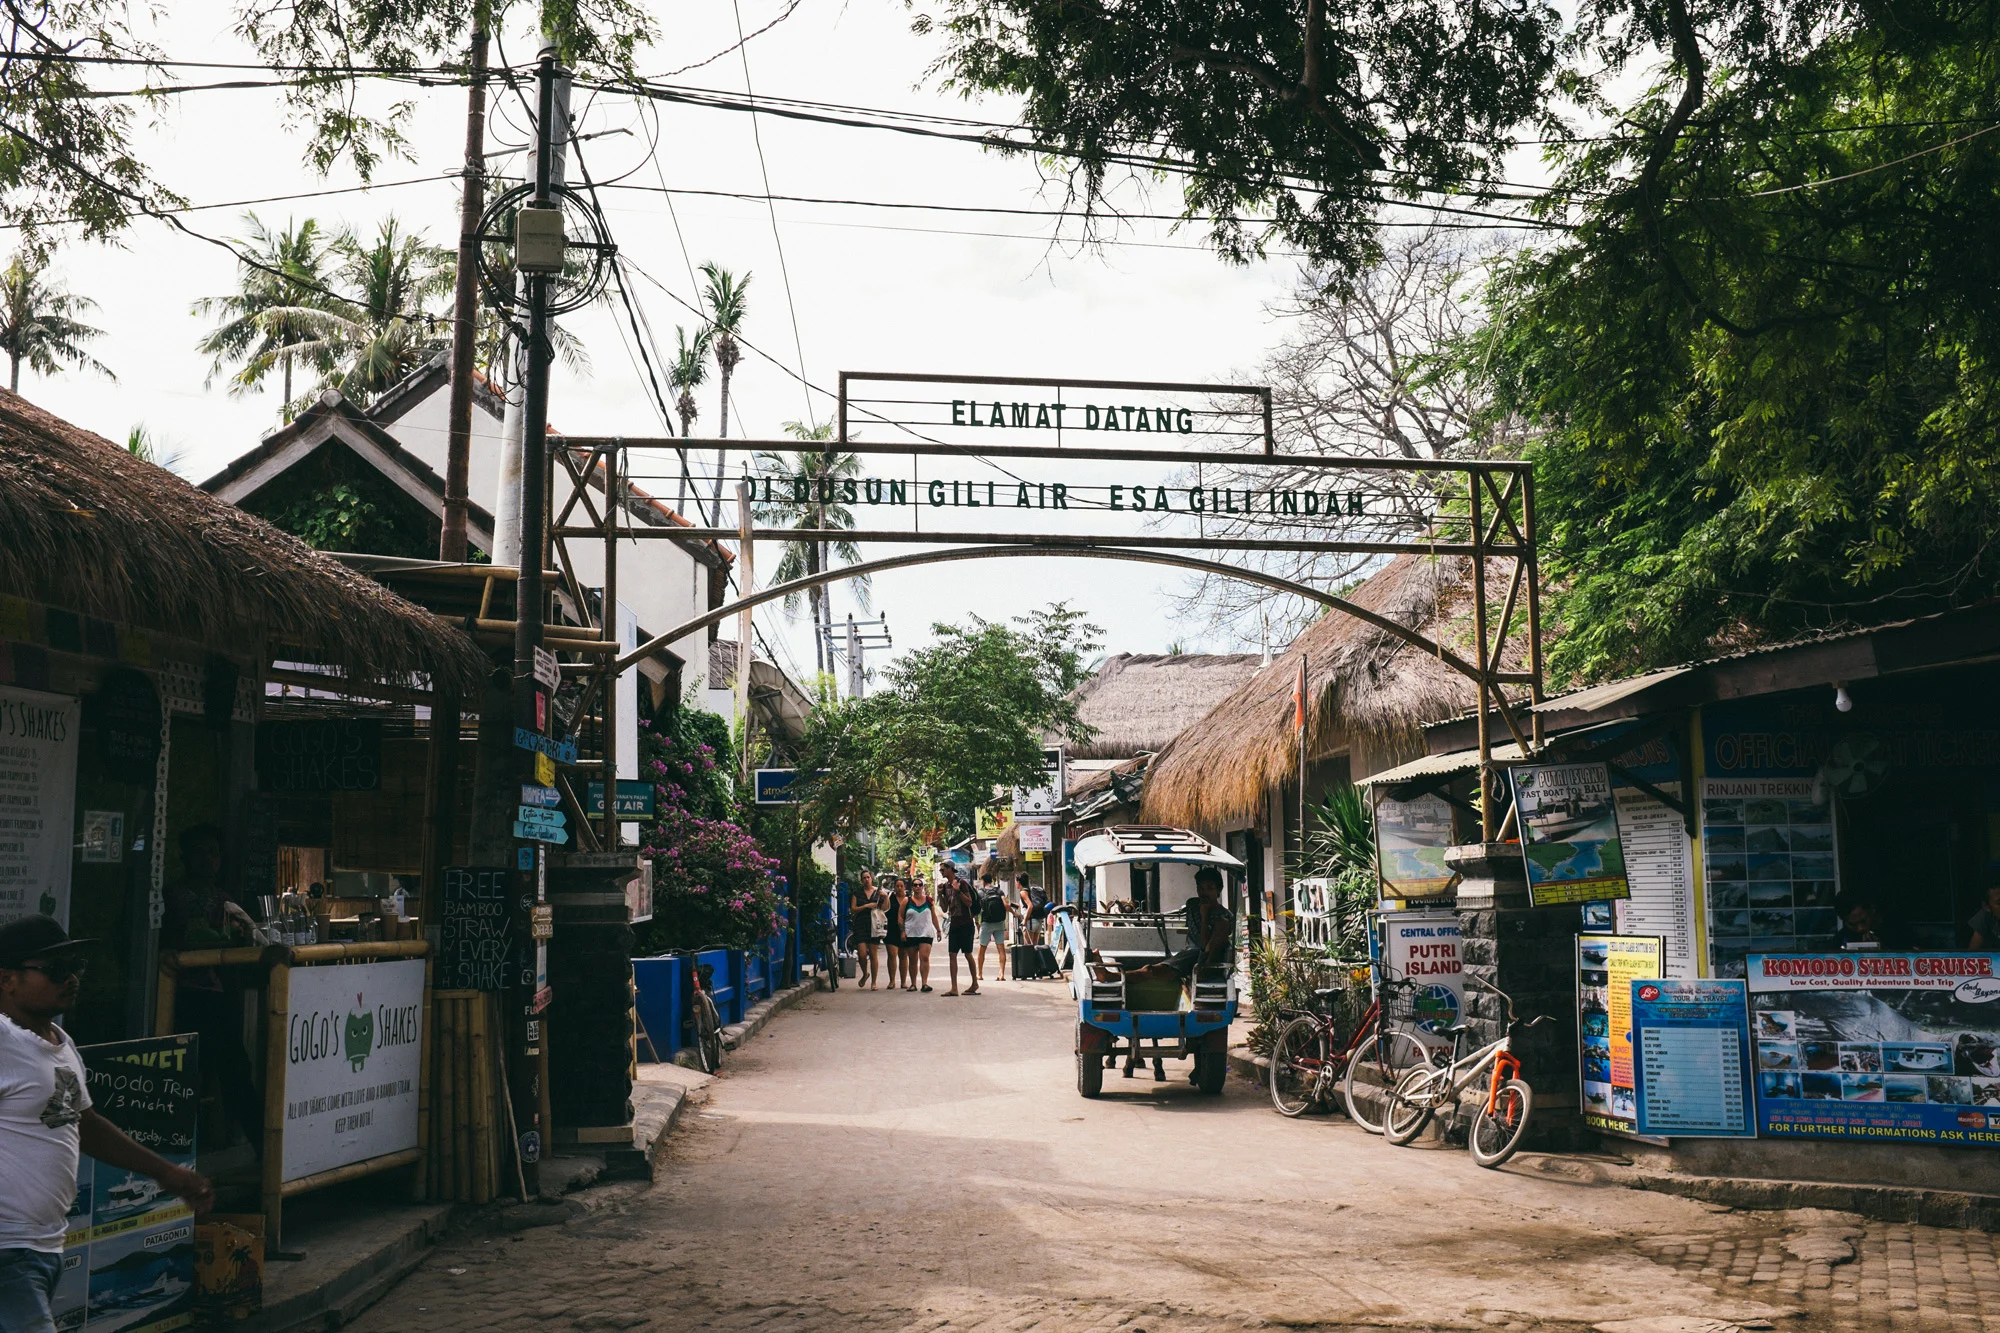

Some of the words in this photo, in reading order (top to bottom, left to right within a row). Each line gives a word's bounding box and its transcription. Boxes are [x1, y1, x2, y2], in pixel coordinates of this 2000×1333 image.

[952, 400, 1066, 429] ELAMAT
[1086, 404, 1193, 434] DATANG
[794, 476, 907, 506] DUSUN
[928, 479, 994, 508] GILI
[1016, 482, 1068, 510] AIR
[1110, 485, 1170, 513] ESA
[1189, 486, 1251, 514] GILI
[1270, 488, 1364, 517] INDAH
[20, 701, 67, 742] SHAKES
[1715, 730, 1832, 770] OFFICIA
[272, 755, 378, 790] SHAKES
[1538, 769, 1568, 788] PUTRI
[1569, 766, 1606, 786] ISLAND
[1520, 790, 1542, 799] FAST
[1543, 788, 1565, 798] BOAT
[1585, 783, 1607, 793] BALI
[1707, 782, 1756, 795] RINJANI
[1760, 782, 1814, 796] TREKKIN
[624, 801, 644, 811] AIR
[443, 870, 506, 901] FREE
[442, 900, 503, 917] BAMBOO
[442, 916, 511, 940] STRAW
[1401, 928, 1436, 938] CENTRAL
[1437, 926, 1463, 936] OFFIC
[458, 937, 513, 963] EVERY
[1409, 944, 1456, 959] PUTRI
[456, 961, 512, 990] SHAKE
[1405, 961, 1463, 975] ISLAND
[1763, 958, 1855, 977] KOMODO
[1858, 957, 1911, 977] STAR
[1913, 956, 1993, 977] CRUISE
[1790, 978, 1807, 986] Low
[1809, 978, 1829, 987] Cost,
[1832, 978, 1864, 987] Quality
[1866, 978, 1911, 986] Adventure
[1913, 978, 1935, 986] Boat
[1937, 978, 1955, 987] Trip
[1962, 982, 1979, 991] And
[1413, 1046, 1435, 1057] FAT
[84, 1066, 154, 1093] omodo
[163, 1078, 195, 1100] TRIP
[131, 1096, 175, 1114] night
[298, 1100, 308, 1117] OUR
[309, 1096, 327, 1116] SHAKES
[327, 1094, 341, 1111] COME
[341, 1091, 353, 1107] WITH
[354, 1088, 365, 1105] LOVE
[366, 1087, 375, 1102] AND
[380, 1081, 397, 1099] BAMBOO
[334, 1117, 346, 1134] KEEP
[347, 1114, 359, 1131] THEM
[1586, 1115, 1606, 1128] BOOK
[1957, 1116, 1986, 1124] MasterCard
[1769, 1123, 1790, 1132] FOR
[1794, 1124, 1845, 1134] FURTHER
[1849, 1126, 1936, 1139] INFORMATIONS
[1940, 1130, 1964, 1140] ASK
[1968, 1131, 2000, 1142] HERE
[78, 1231, 86, 1241] PM
[145, 1228, 188, 1247] PATAGONIA
